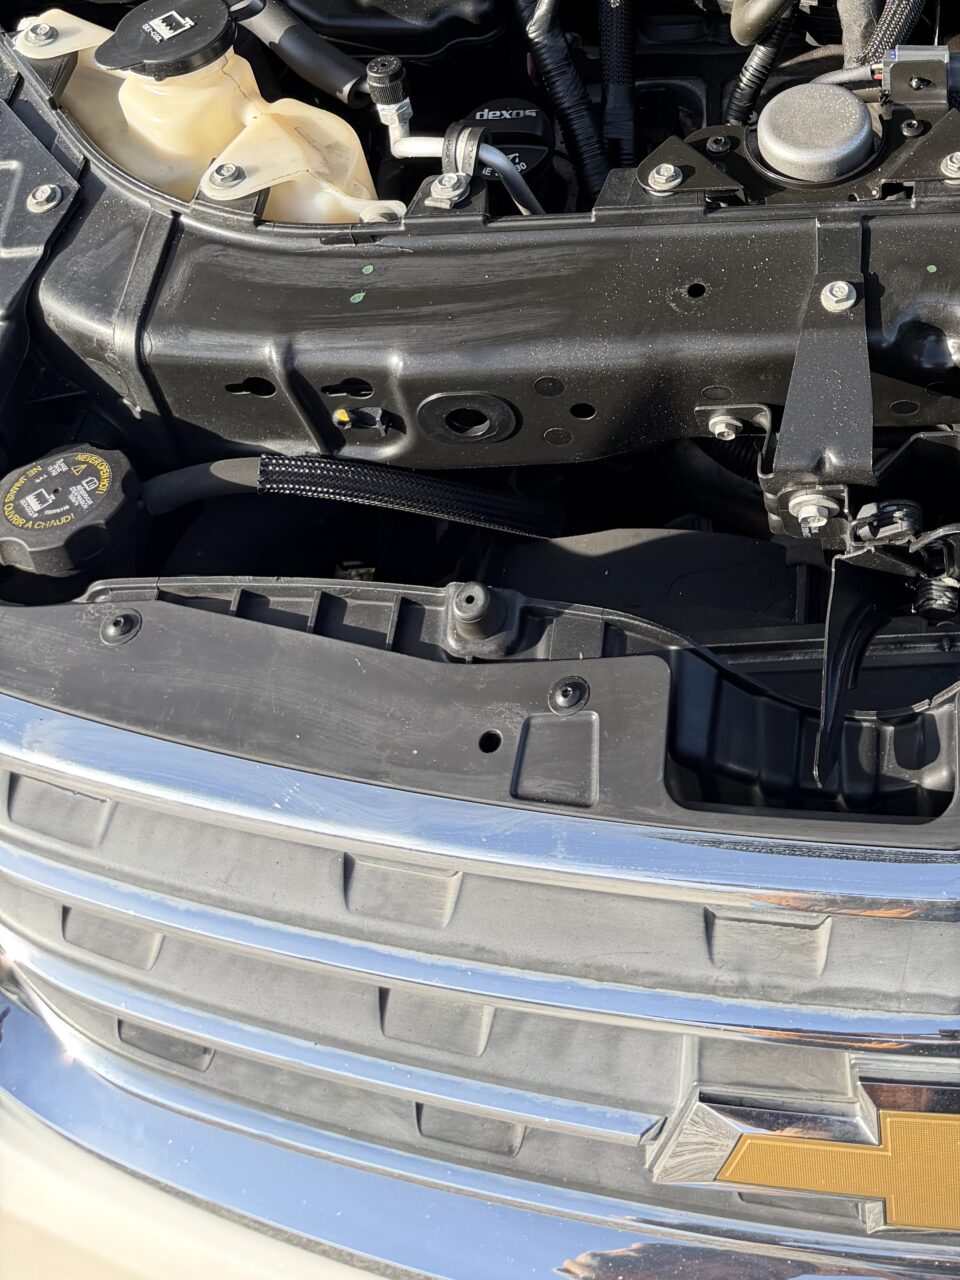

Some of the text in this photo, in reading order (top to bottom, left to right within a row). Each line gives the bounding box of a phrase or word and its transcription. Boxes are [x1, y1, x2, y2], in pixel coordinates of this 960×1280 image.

[475, 108, 538, 120] dexos
[75, 453, 102, 467] NEVER
[26, 465, 43, 478] NE
[5, 475, 27, 502] JAMAIS
[4, 503, 26, 527] OUVRIR
[34, 512, 75, 529] CHAUD!
